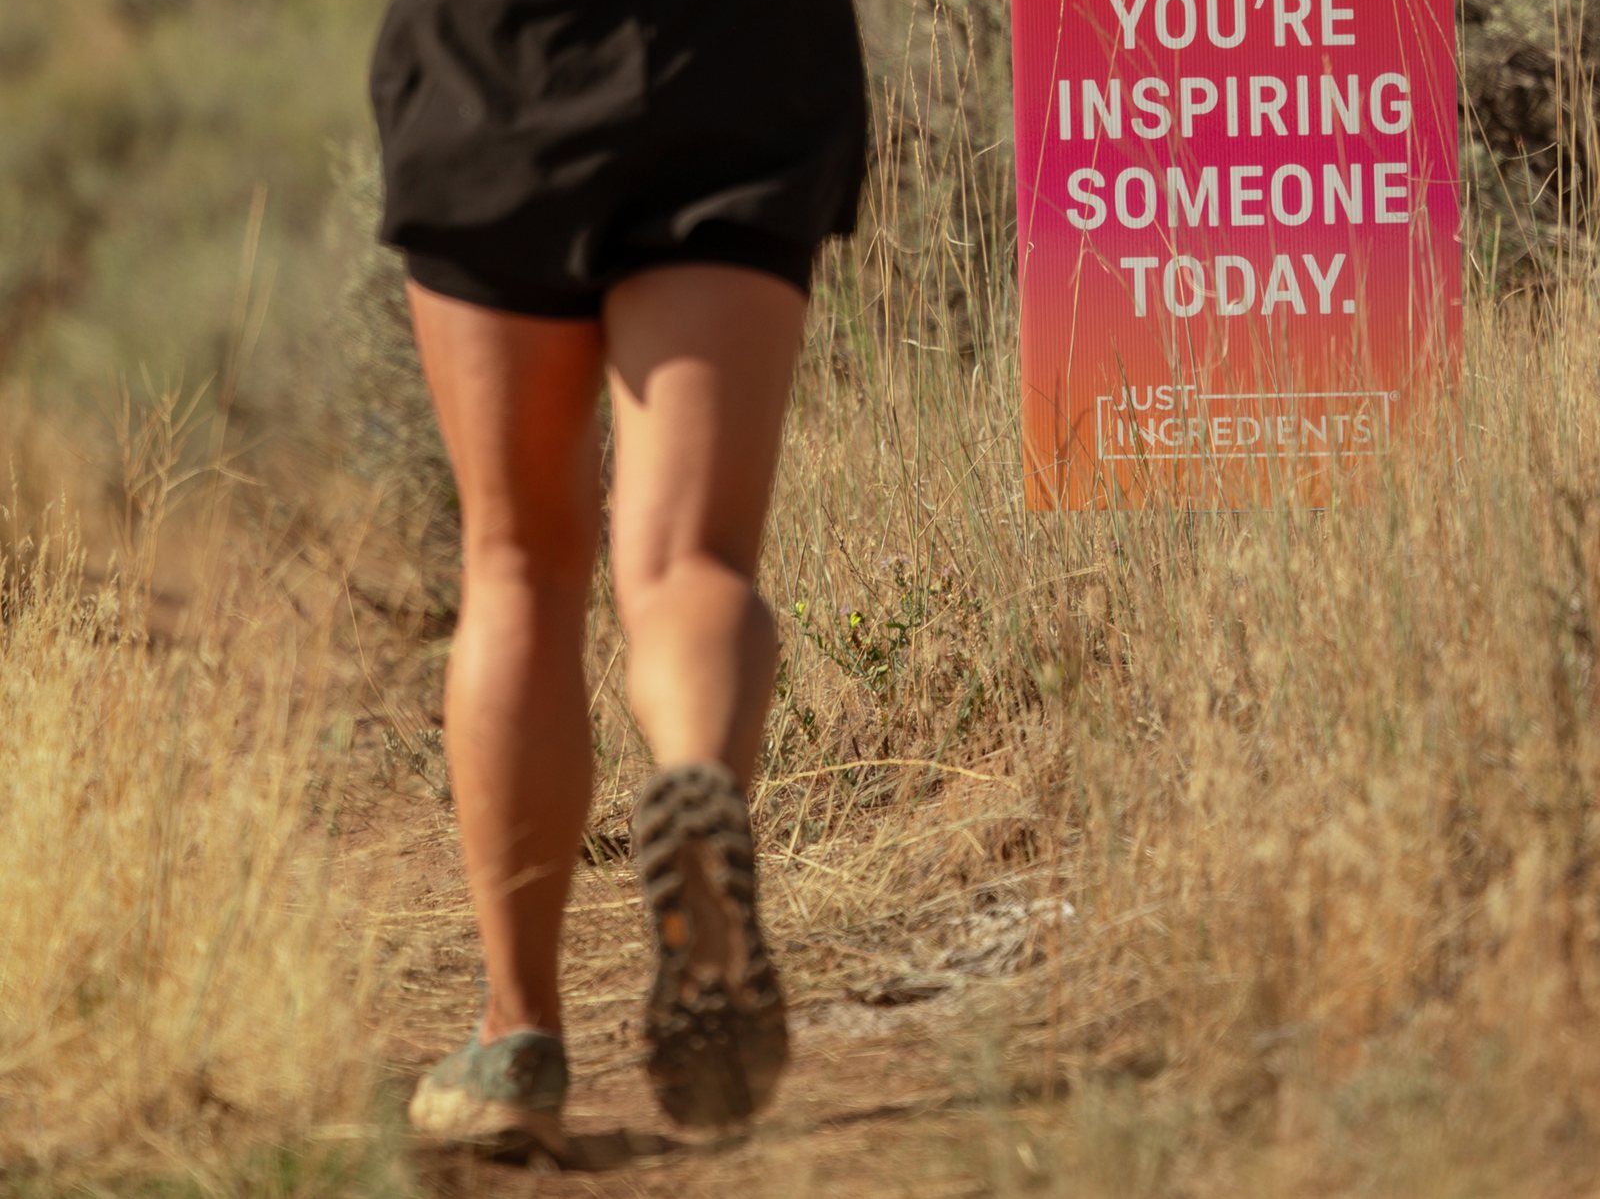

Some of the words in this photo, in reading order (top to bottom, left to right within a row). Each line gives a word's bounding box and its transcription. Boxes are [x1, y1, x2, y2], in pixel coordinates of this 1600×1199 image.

[1058, 72, 1412, 141] INSPIRING
[1066, 162, 1410, 230] SOMEONE
[1120, 253, 1356, 318] TODAY.
[1113, 384, 1196, 411] JUST
[1116, 414, 1373, 447] INGREDIENTS
